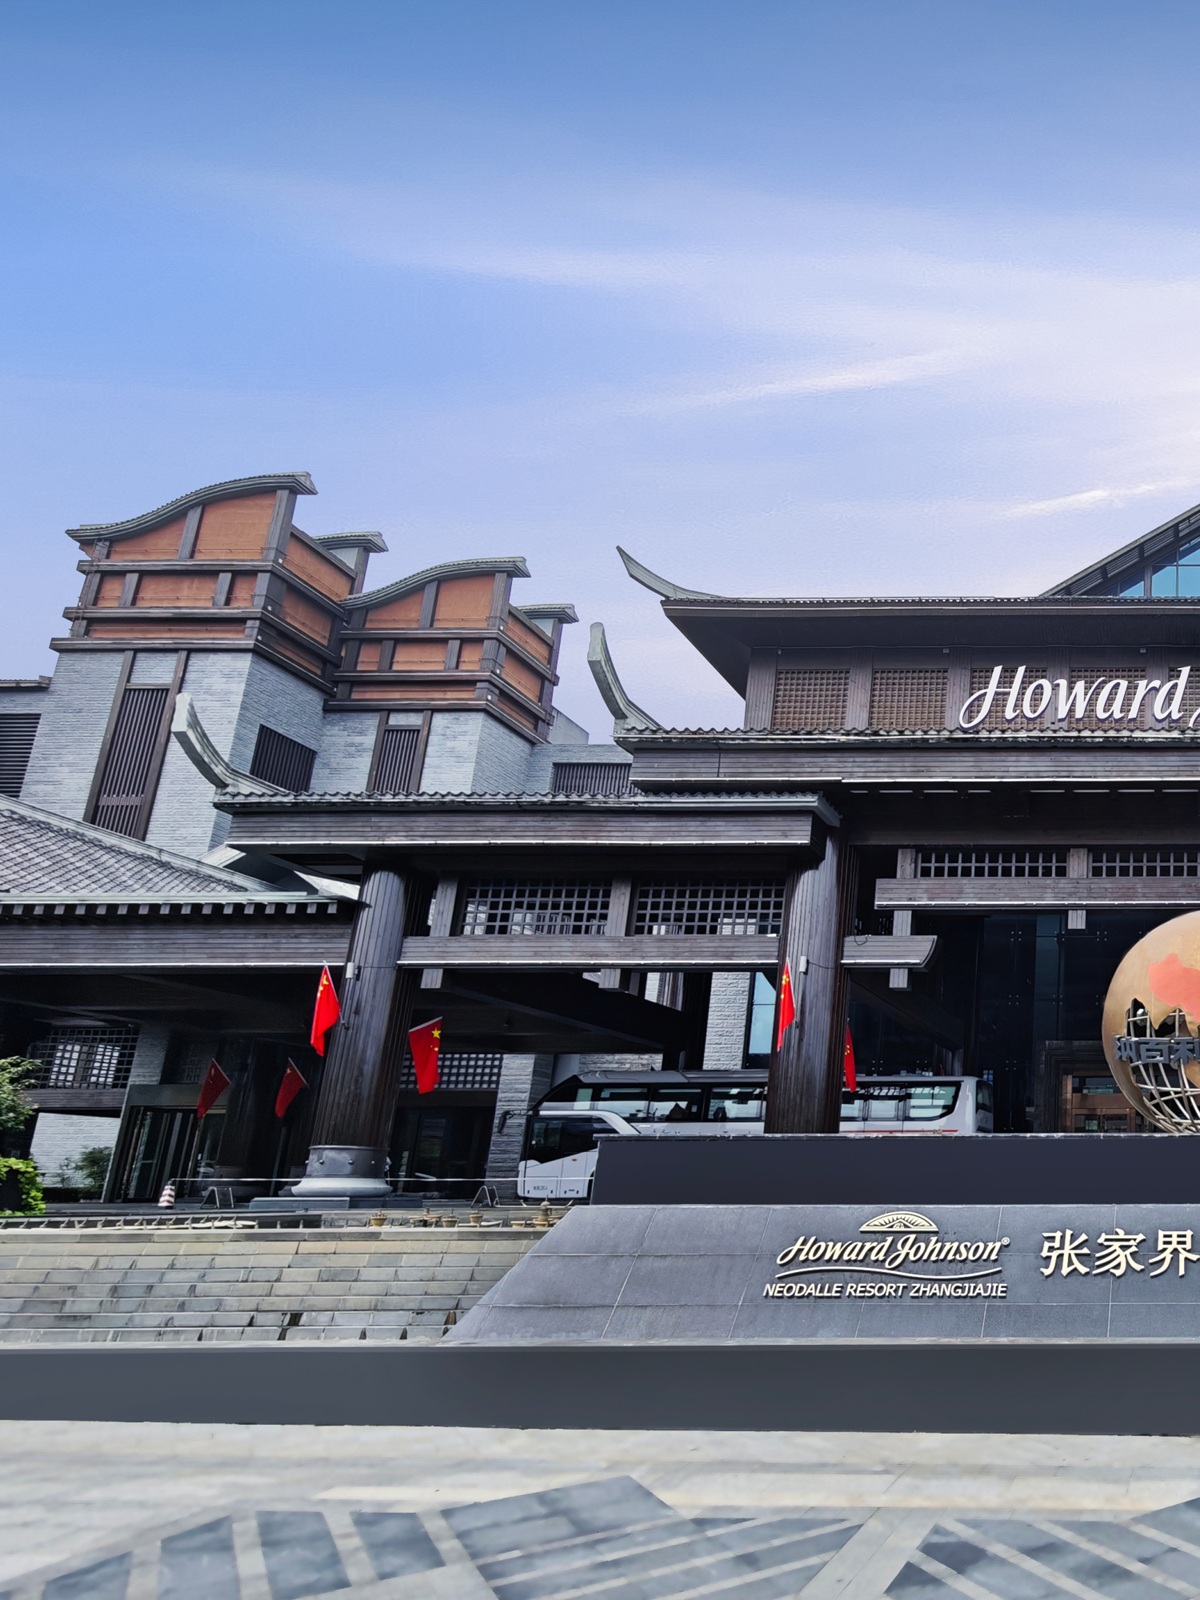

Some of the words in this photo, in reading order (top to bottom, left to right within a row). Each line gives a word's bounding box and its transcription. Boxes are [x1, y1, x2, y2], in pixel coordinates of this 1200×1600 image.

[959, 664, 1191, 730] Howard
[776, 1236, 893, 1265] Howard
[763, 1283, 842, 1297] NEODALLE
[846, 1283, 908, 1297] RESORT
[909, 1283, 1008, 1298] ZHANGJIAJIE
